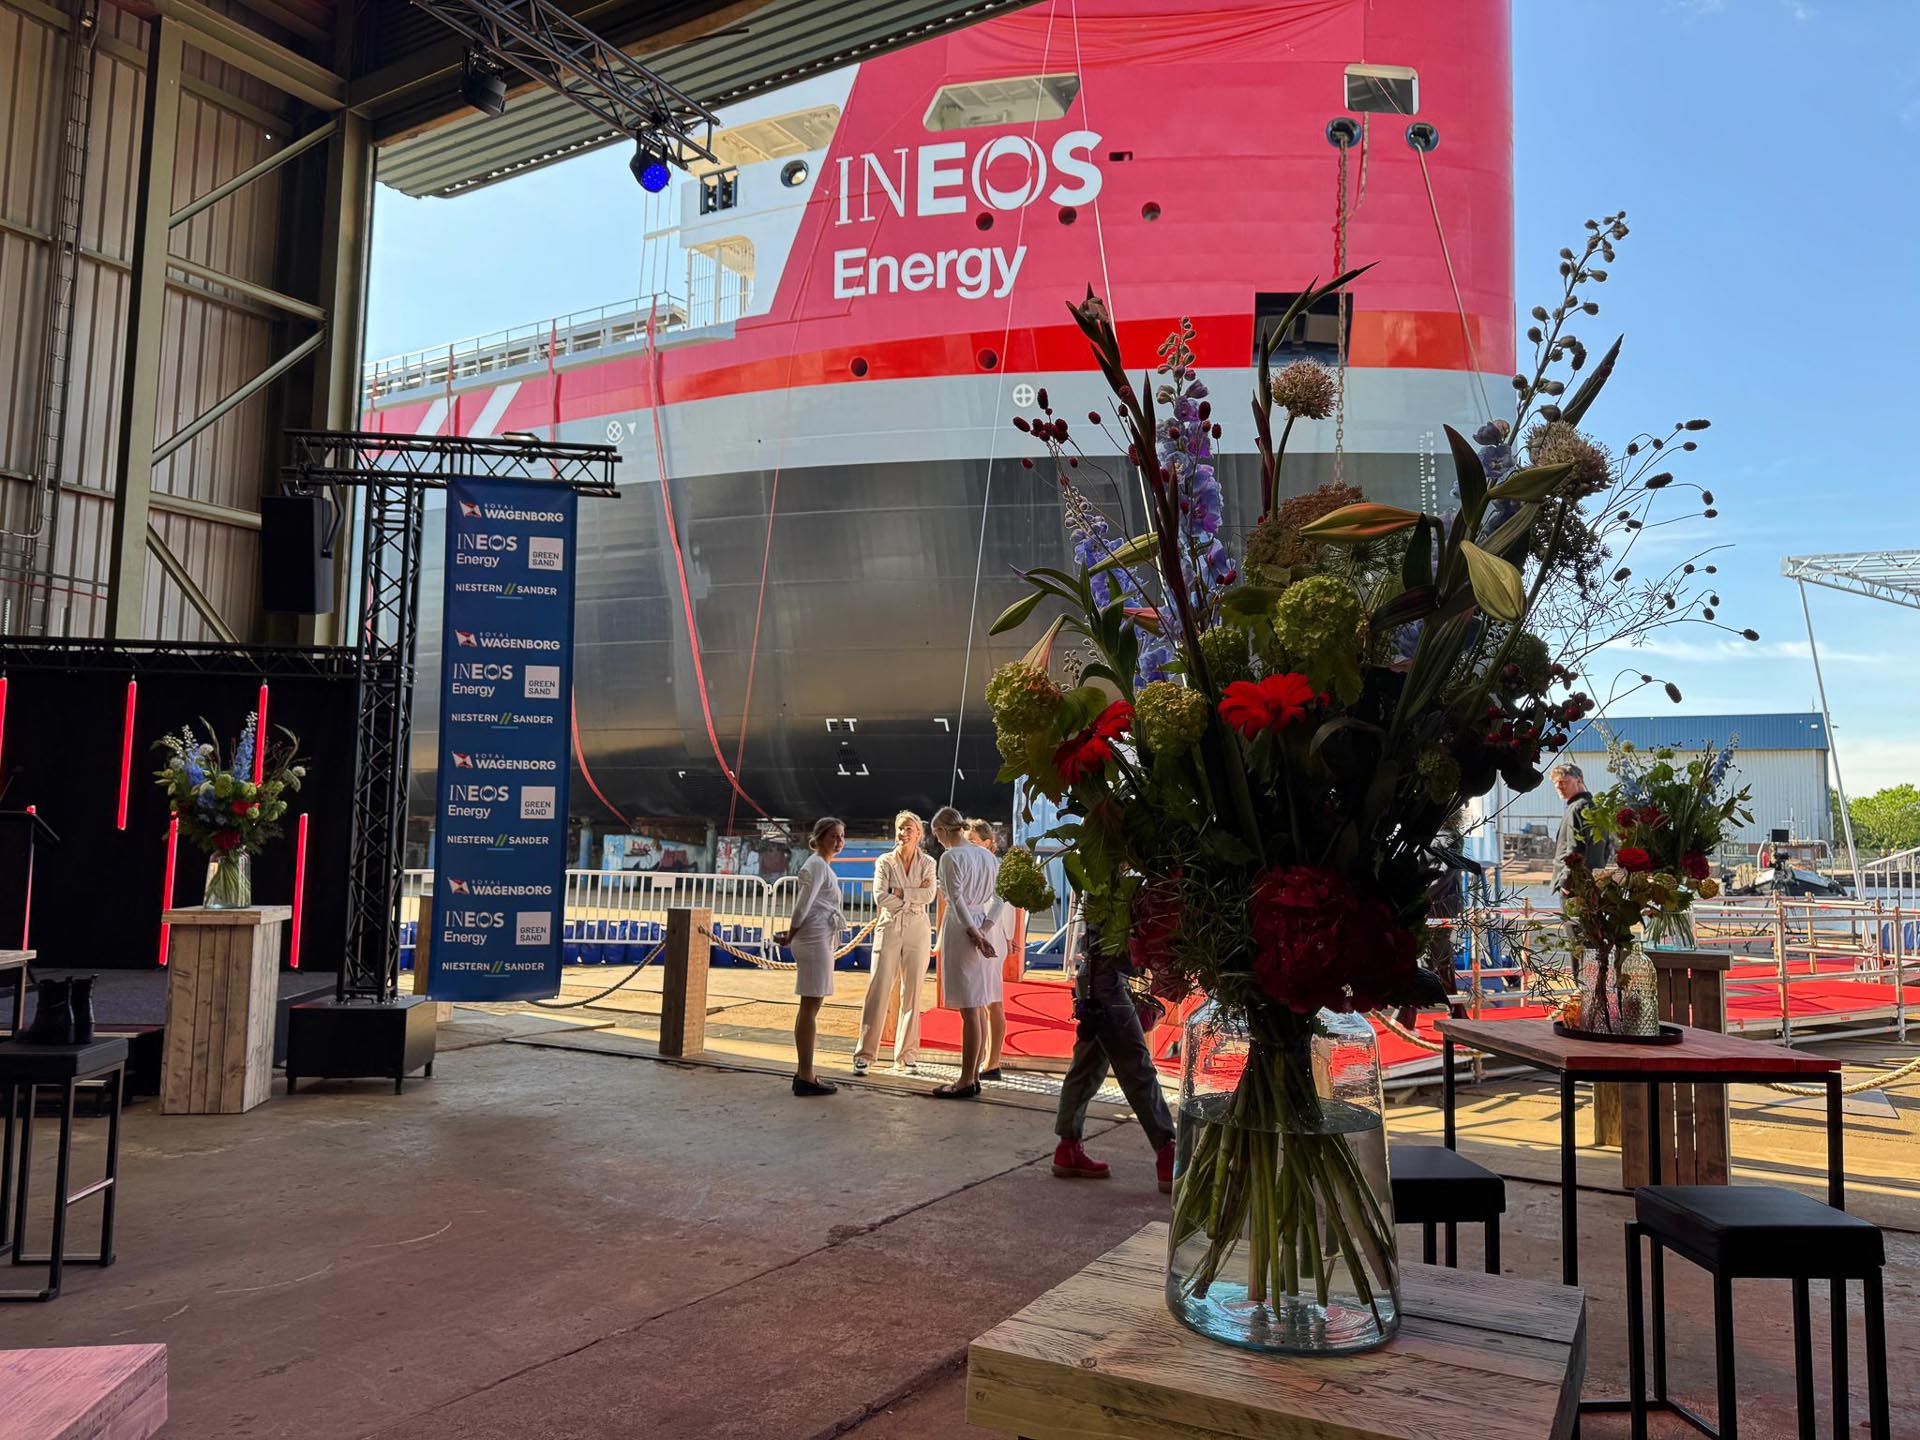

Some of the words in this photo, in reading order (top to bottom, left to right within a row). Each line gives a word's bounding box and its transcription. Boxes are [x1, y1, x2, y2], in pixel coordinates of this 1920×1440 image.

[834, 130, 1103, 227] INEOS
[834, 245, 1027, 300] Energy
[485, 509, 564, 522] WAGENBORG
[457, 533, 518, 551] INEOS
[456, 553, 500, 568] Energy
[532, 551, 559, 559] GREEN
[532, 559, 555, 567] SAND
[455, 583, 503, 593] NIESTERN
[517, 585, 558, 596] SANDER
[480, 638, 561, 650] WAGENBORG
[453, 663, 513, 680] INEOS
[452, 683, 496, 697] Energy
[528, 680, 556, 688] GREEN
[451, 713, 499, 722] NIESTERN
[512, 714, 554, 724] SANDER
[476, 759, 556, 770] WAGENBORG
[449, 784, 509, 802] INEOS
[448, 805, 491, 819] Energy
[524, 808, 547, 816] SAND
[447, 835, 494, 844] NIESTERN
[508, 836, 549, 845] SANDER
[471, 885, 552, 896] WAGENBORG
[445, 910, 505, 928] INEOS
[520, 926, 547, 934] GREEN
[443, 931, 487, 946] Energy
[520, 934, 542, 942] SAND
[442, 962, 490, 971] NIESTERN
[504, 962, 545, 971] SANDER
